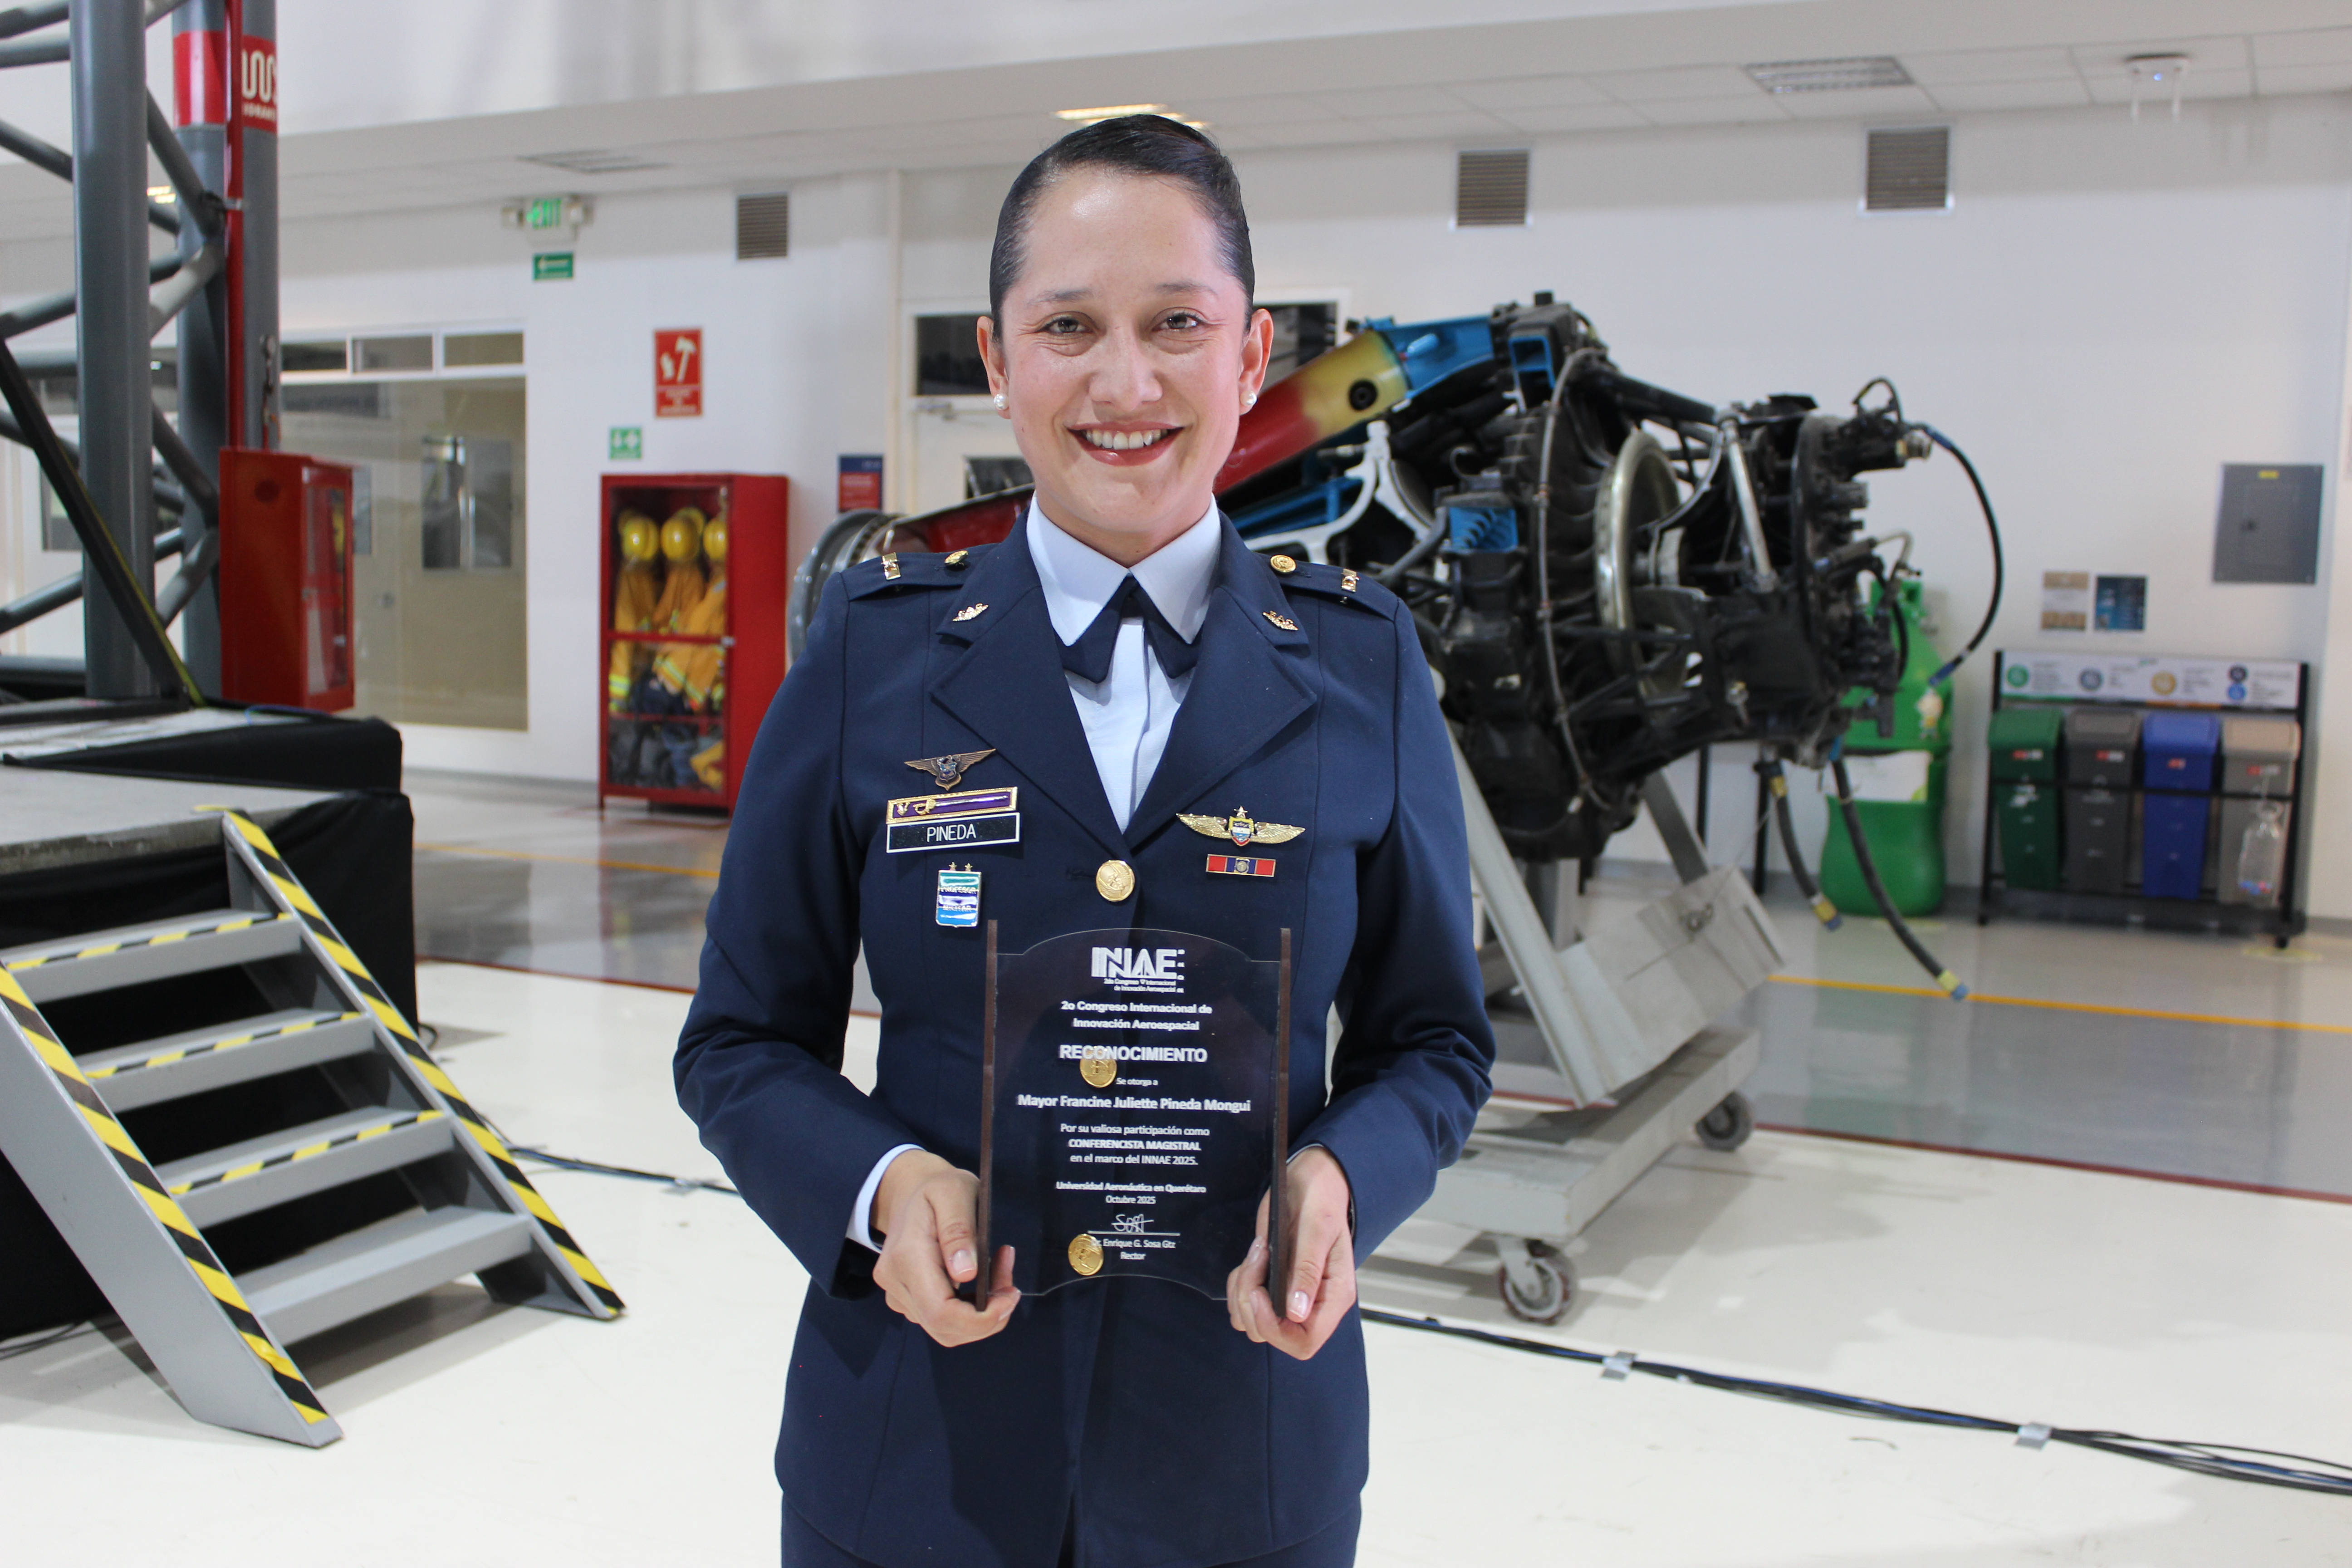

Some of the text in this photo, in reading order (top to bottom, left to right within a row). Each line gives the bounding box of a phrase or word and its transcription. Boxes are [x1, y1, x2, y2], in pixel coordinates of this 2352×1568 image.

[533, 197, 562, 229] EXIT
[926, 823, 976, 843] PINEDA
[1114, 978, 1140, 986] Congreso
[1061, 1000, 1213, 1014] 2o Congreso Internacional de
[1073, 1018, 1200, 1032] Innovación Aeroespacial
[1058, 1044, 1208, 1062] RECONOCIMIENTO
[1116, 1077, 1126, 1086] Se
[1127, 1078, 1152, 1087] otorga
[1017, 1094, 1251, 1114] Mayor Francine Juliette Pineda Mongui
[1060, 1123, 1078, 1132] Por
[1090, 1124, 1122, 1134] valiosa
[1123, 1125, 1182, 1137] participación
[1068, 1138, 1202, 1151] CONFERENCISTA MAGISTRAL
[1084, 1153, 1093, 1163] el
[1125, 1154, 1140, 1164] del
[1141, 1155, 1171, 1165] INNAE
[1172, 1156, 1198, 1165] 2025.
[1056, 1181, 1104, 1191] Universidad
[1104, 1182, 1153, 1192] Aeronáutica
[1164, 1184, 1207, 1193] Querétaro
[1105, 1195, 1156, 1204] Octubre 2025
[1102, 1238, 1133, 1249] Enrique
[1134, 1239, 1142, 1248] G.
[1143, 1240, 1161, 1248] Sosa
[1161, 1240, 1176, 1249] Gtz
[1120, 1251, 1146, 1260] Rector
